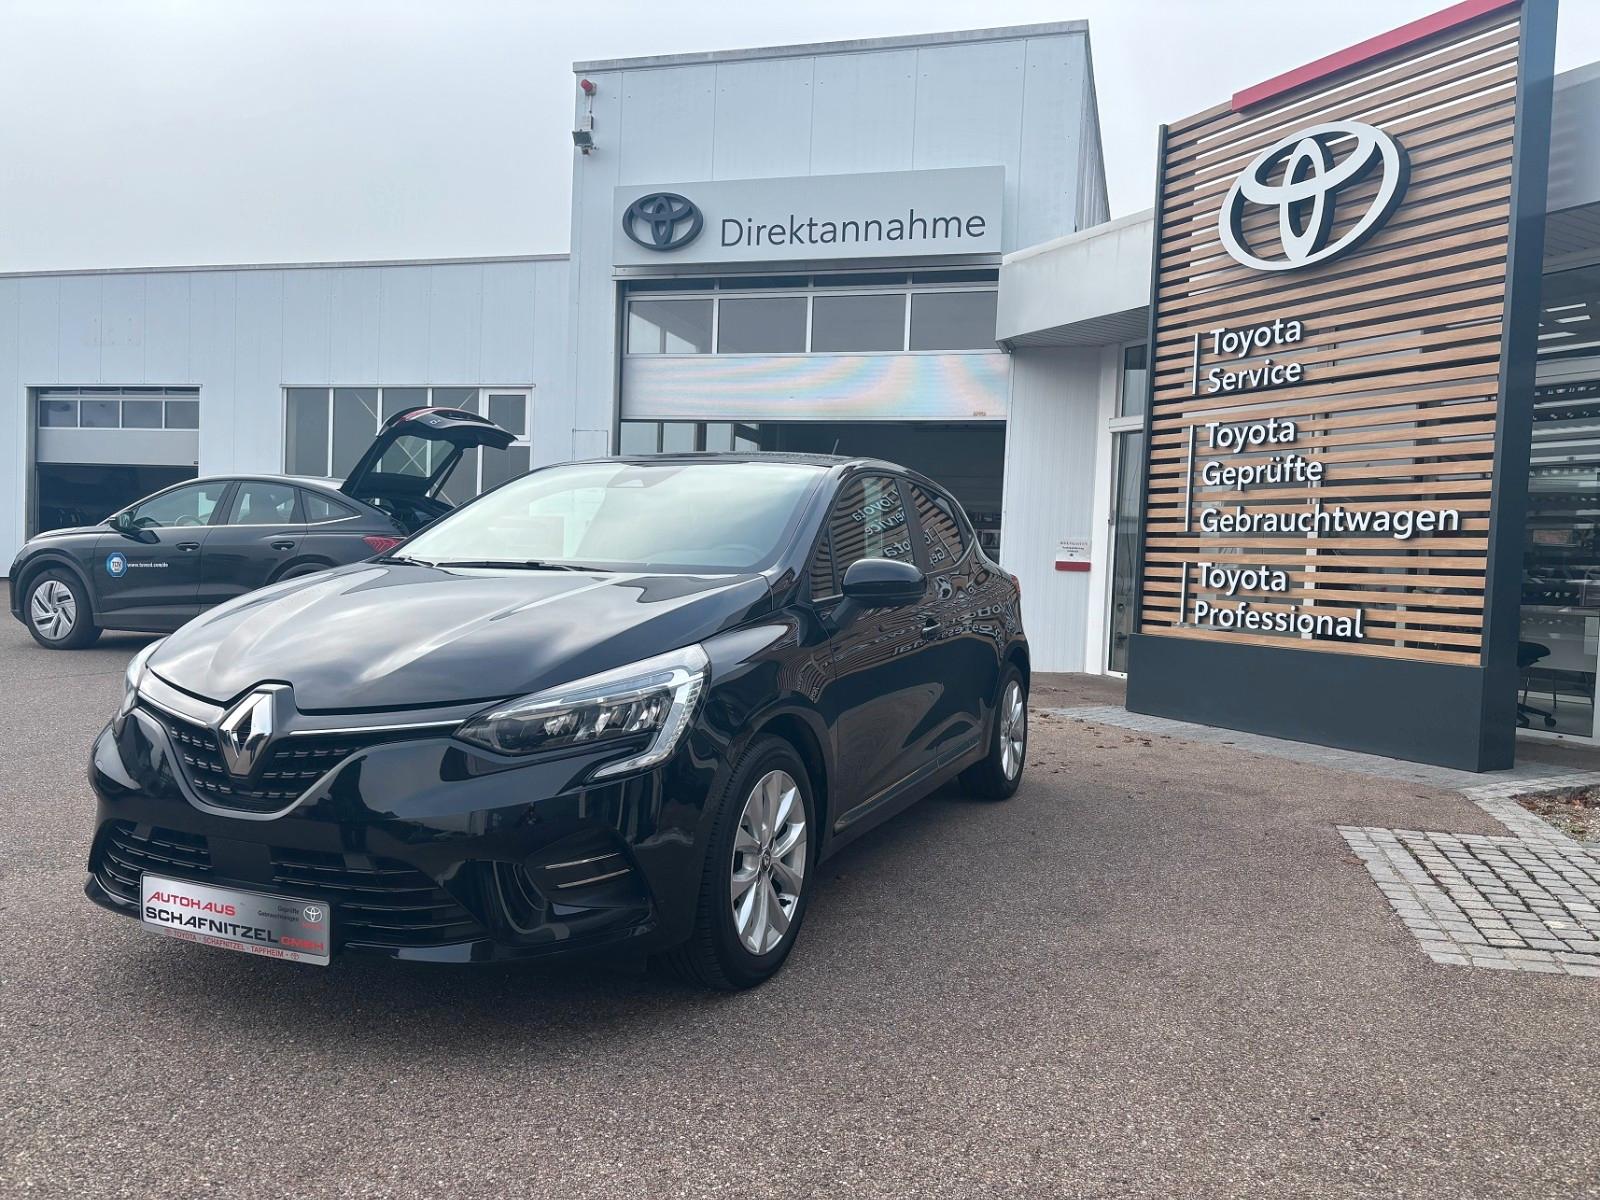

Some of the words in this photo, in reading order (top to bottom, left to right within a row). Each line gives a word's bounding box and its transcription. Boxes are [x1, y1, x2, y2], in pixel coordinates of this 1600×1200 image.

[720, 208, 986, 247] Direktannahme
[1209, 318, 1303, 358] Toyota
[1207, 358, 1303, 393] Service
[1204, 417, 1297, 453] Toyota
[1201, 455, 1323, 491] Geprüfte
[1199, 503, 1460, 540] Gebrauchtwagen
[1197, 562, 1289, 596] Toyota
[1193, 600, 1364, 639] Professional
[146, 891, 236, 916] AUTOHAUS
[145, 906, 279, 944] SCHAFNITZEL
[173, 931, 197, 941] TOYOTA
[203, 936, 245, 951] SCHAFNITZEL
